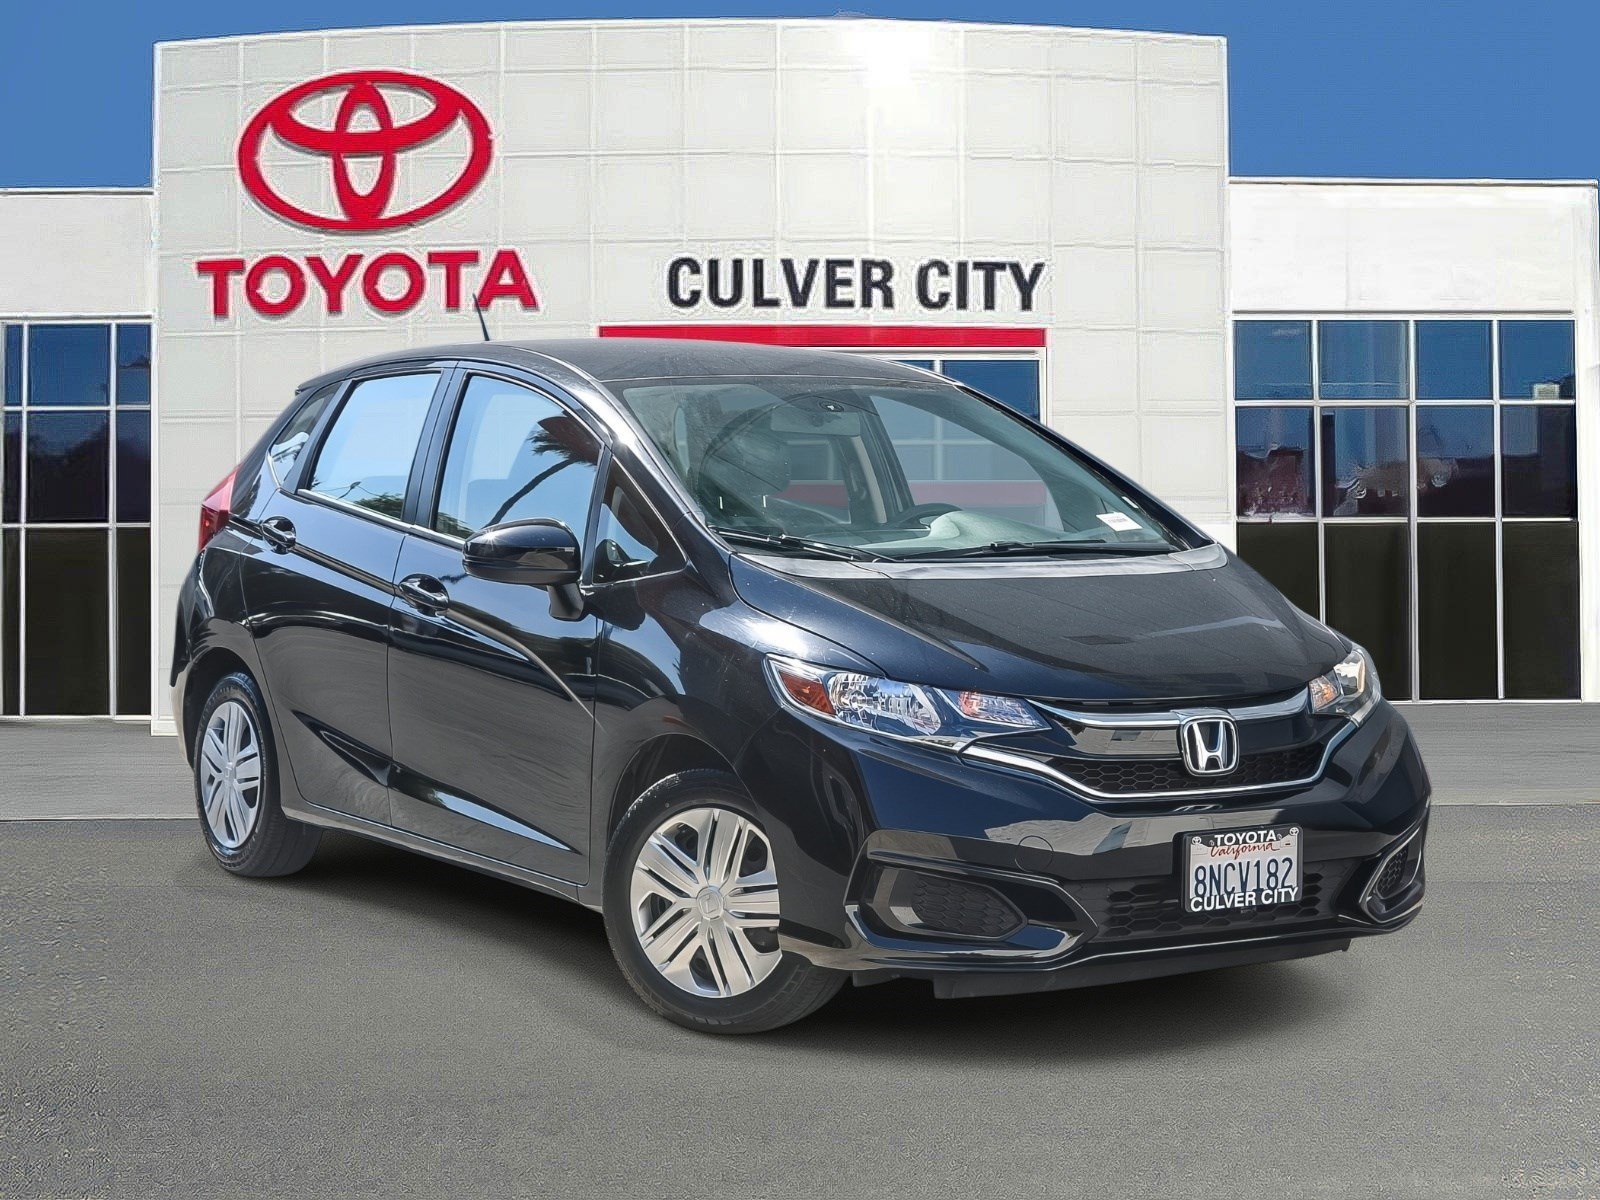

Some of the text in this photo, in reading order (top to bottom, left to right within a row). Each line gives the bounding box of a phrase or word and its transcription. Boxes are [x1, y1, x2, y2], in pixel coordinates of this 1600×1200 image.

[196, 249, 538, 318] TOYOTA
[666, 256, 1046, 312] CULVER CITY
[1210, 842, 1281, 859] California
[1214, 830, 1277, 846] TOYOTA
[1194, 857, 1294, 897] 8NCV182
[1190, 887, 1299, 912] CULVER CITY
